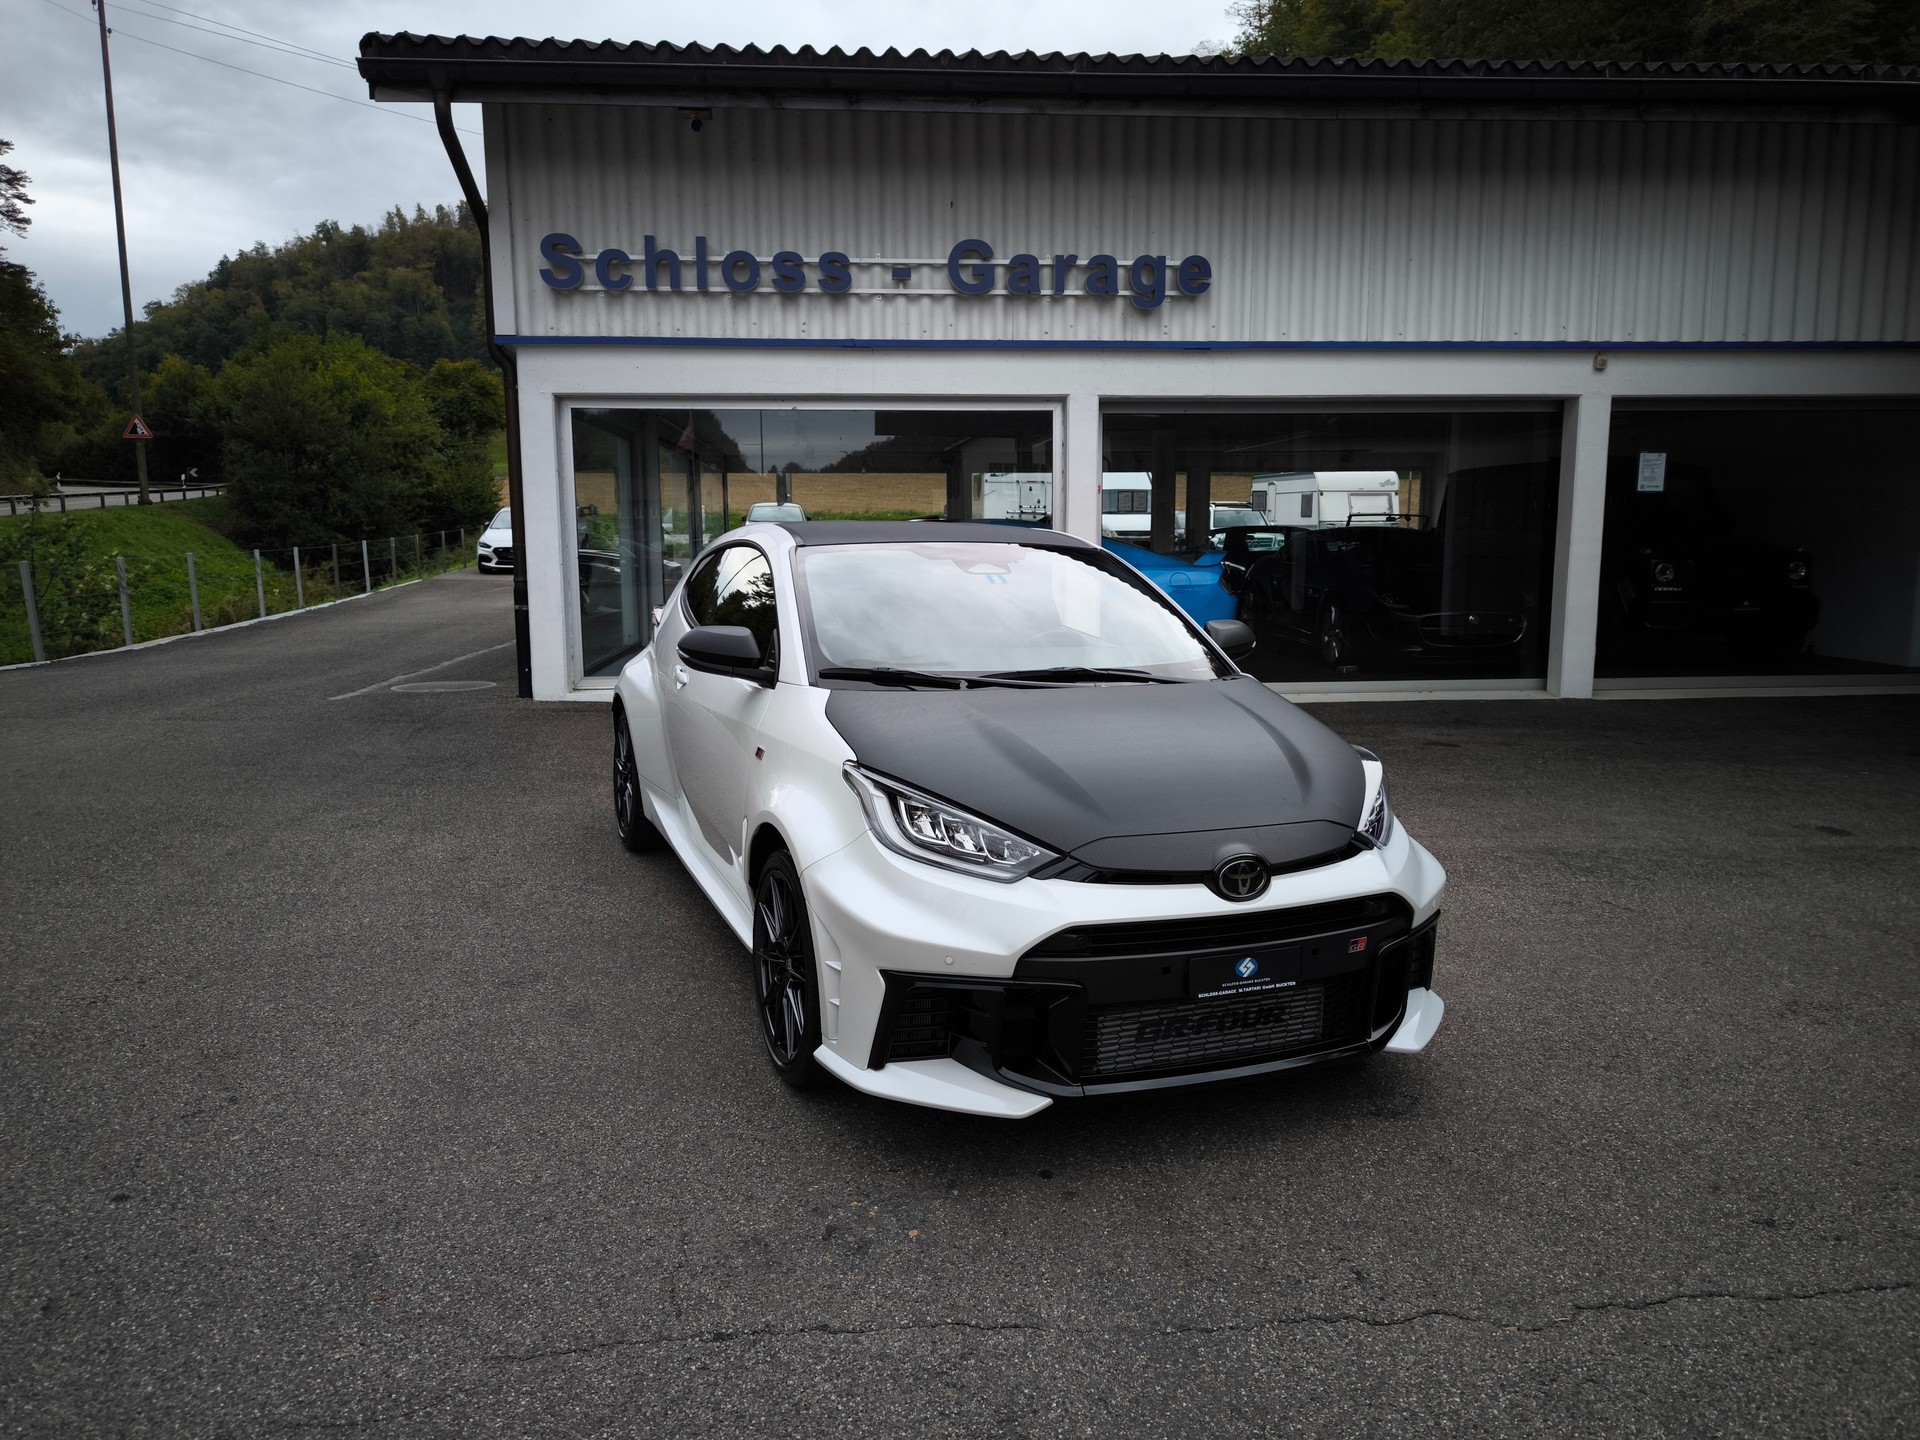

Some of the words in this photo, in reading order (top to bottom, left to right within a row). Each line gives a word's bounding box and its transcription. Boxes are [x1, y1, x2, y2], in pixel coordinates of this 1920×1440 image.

[540, 233, 854, 293] Schloss
[948, 239, 1213, 309] Garage
[1349, 941, 1366, 953] GR
[1198, 989, 1237, 998] SCHLOSS-GARAGE
